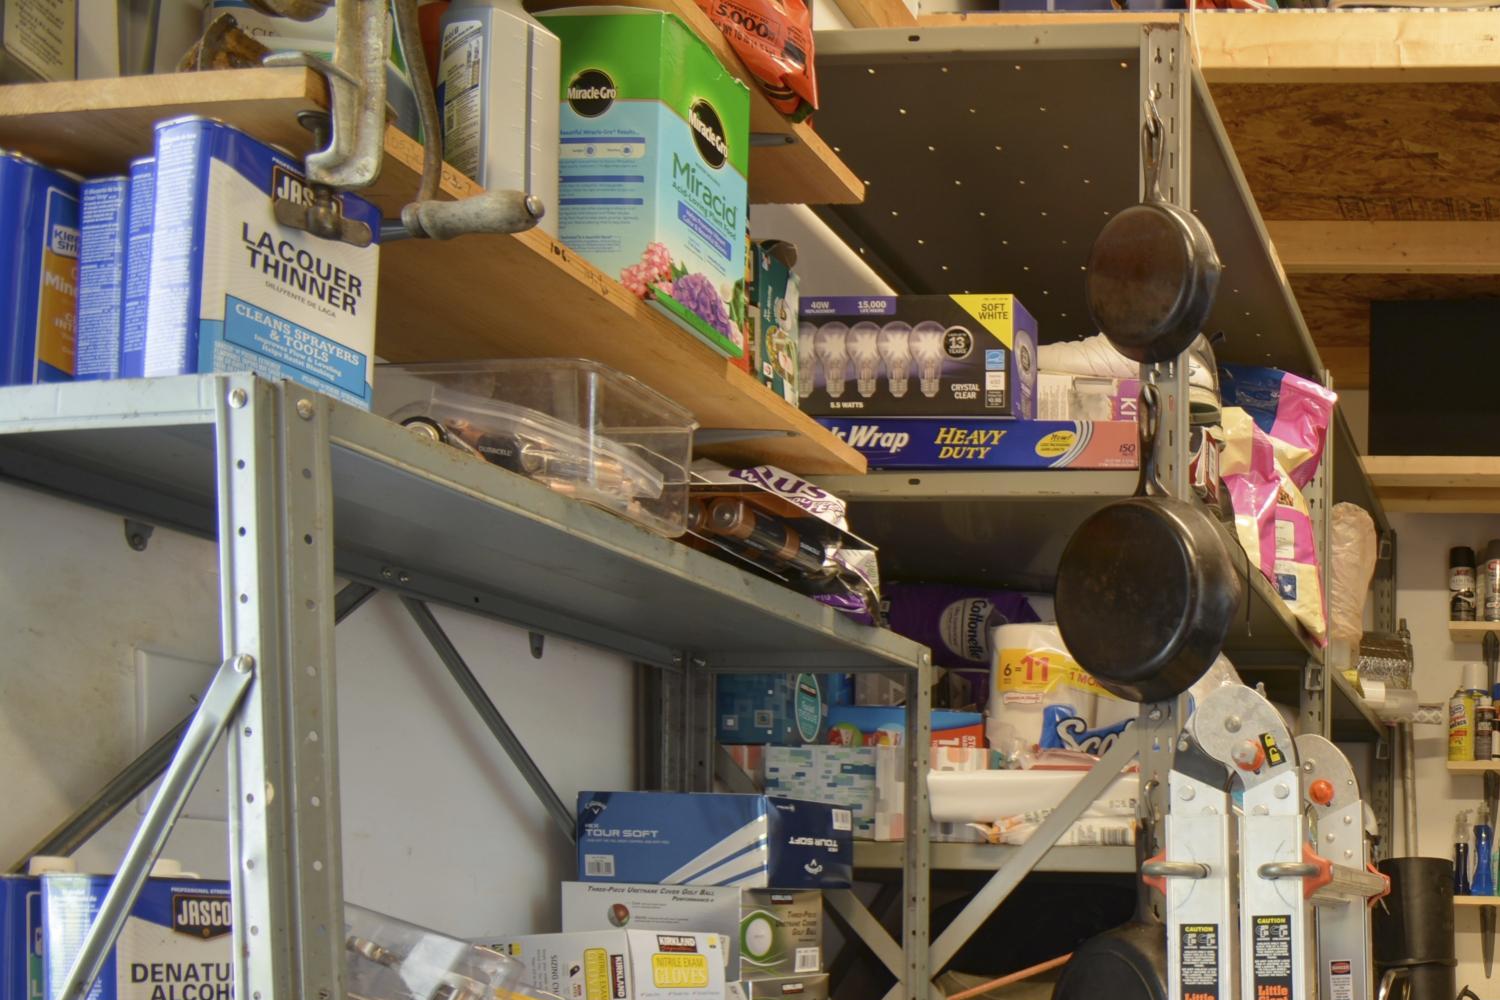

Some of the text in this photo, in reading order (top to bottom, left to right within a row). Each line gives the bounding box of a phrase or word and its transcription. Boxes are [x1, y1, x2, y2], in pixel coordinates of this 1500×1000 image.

[672, 151, 737, 229] Miracid
[242, 222, 363, 297] LACQUER
[246, 245, 357, 316] THINNER
[978, 311, 1009, 320] WHITE
[981, 303, 1006, 312] SOFT
[235, 304, 291, 335] CLEANS
[295, 329, 359, 366] SPRAYERS
[949, 336, 965, 350] 13
[285, 336, 329, 362] TOOLS
[951, 383, 980, 392] CRYSTAL
[954, 391, 977, 400] CLEAR
[849, 425, 910, 453] Wrap
[934, 428, 1007, 446] HEAVY
[938, 446, 991, 459] DUTY
[967, 600, 987, 661] Cottonelle
[1004, 656, 1049, 682] 6 11
[585, 829, 659, 838] TOUR SOFT
[177, 900, 232, 927] JASCO
[659, 936, 696, 947] KIRKLAND
[131, 963, 234, 983] DENATU
[615, 956, 626, 998] KIRKLAND
[655, 969, 705, 985] GLOVES
[1258, 985, 1288, 996] Little
